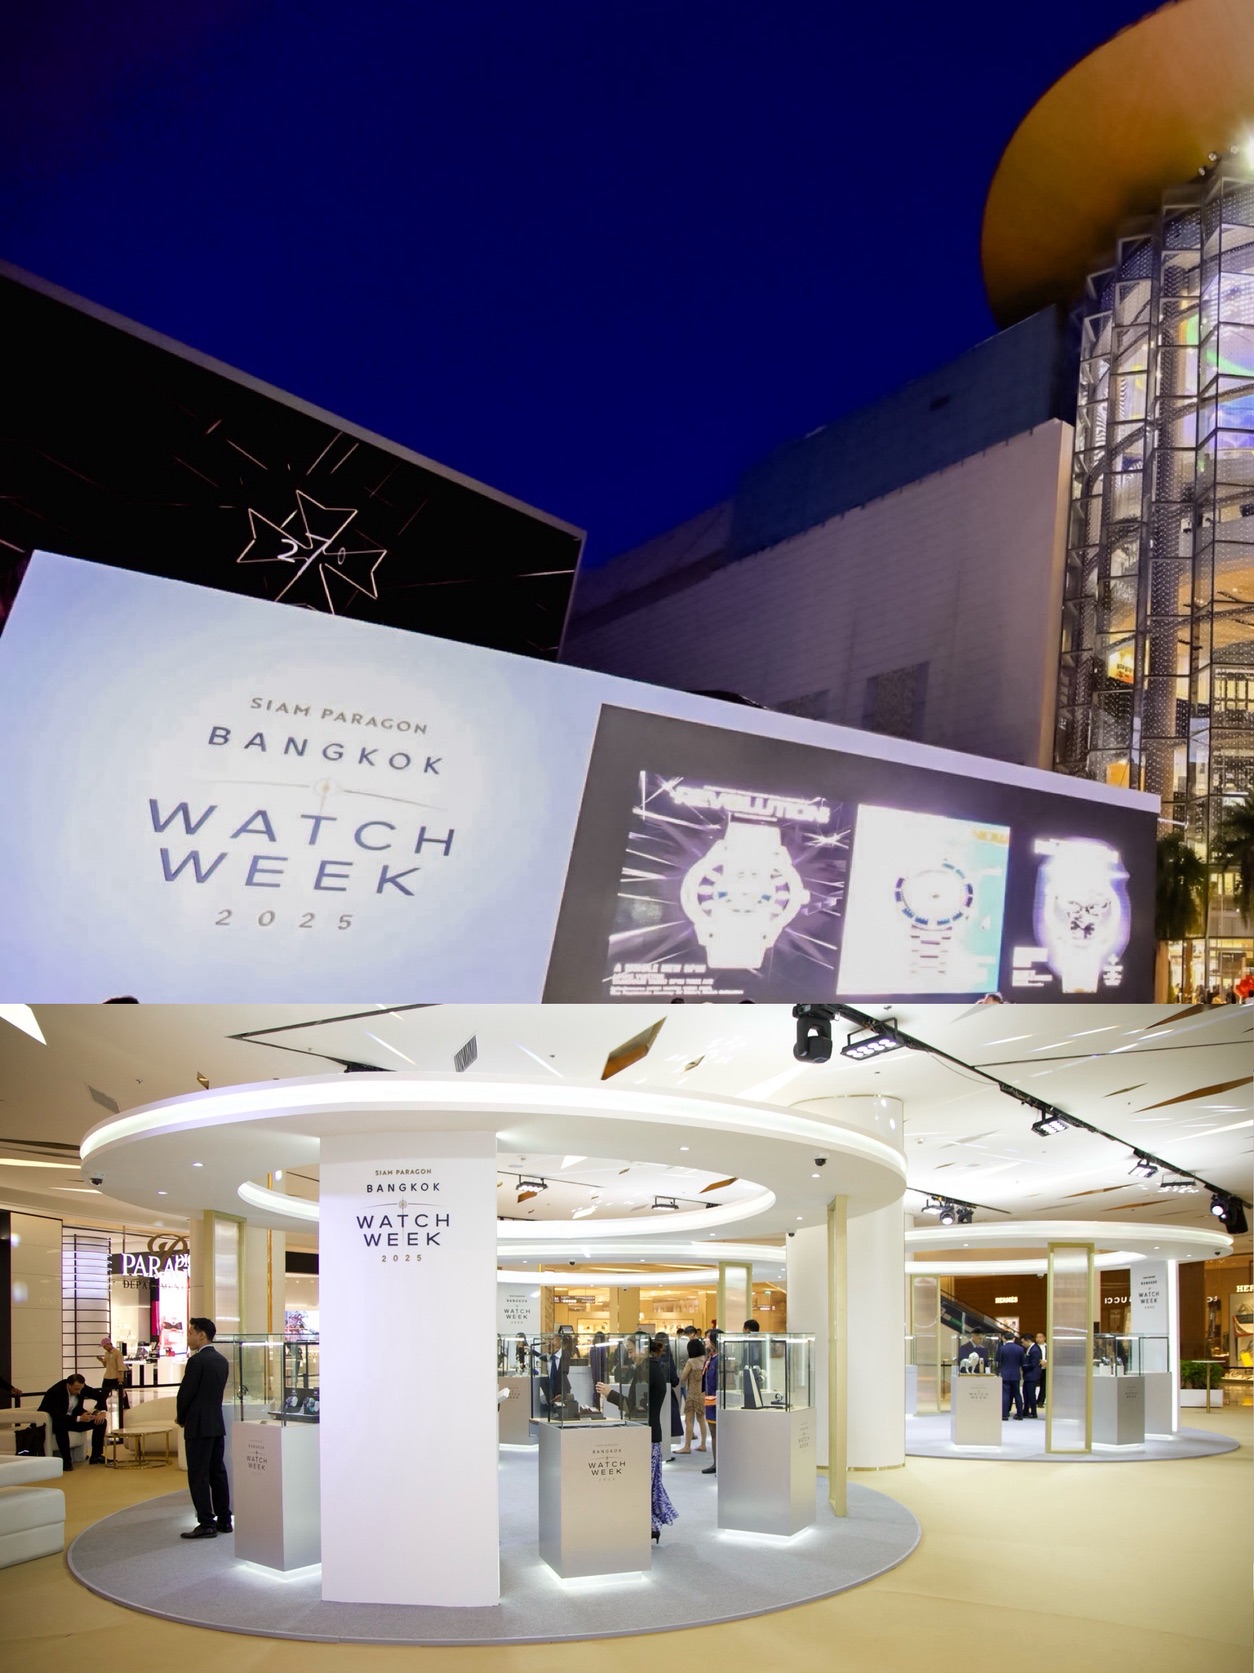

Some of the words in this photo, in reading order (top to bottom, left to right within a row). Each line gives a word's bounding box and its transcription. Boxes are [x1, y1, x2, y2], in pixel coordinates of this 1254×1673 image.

[249, 696, 311, 717] SIAM
[321, 708, 428, 736] PARAGON
[208, 725, 443, 775] BANGKOK
[149, 798, 455, 857] WATCH
[159, 847, 422, 896] WEEK
[214, 908, 354, 931] 2025
[366, 1182, 440, 1193] BANGKOK
[356, 1213, 450, 1229] WATCH
[363, 1231, 441, 1247] WEEK
[381, 1254, 422, 1262] 2025
[246, 1455, 268, 1464] WATCH
[247, 1462, 266, 1471] WEEK
[587, 1460, 626, 1469] WATCH
[590, 1468, 623, 1476] WEEK
